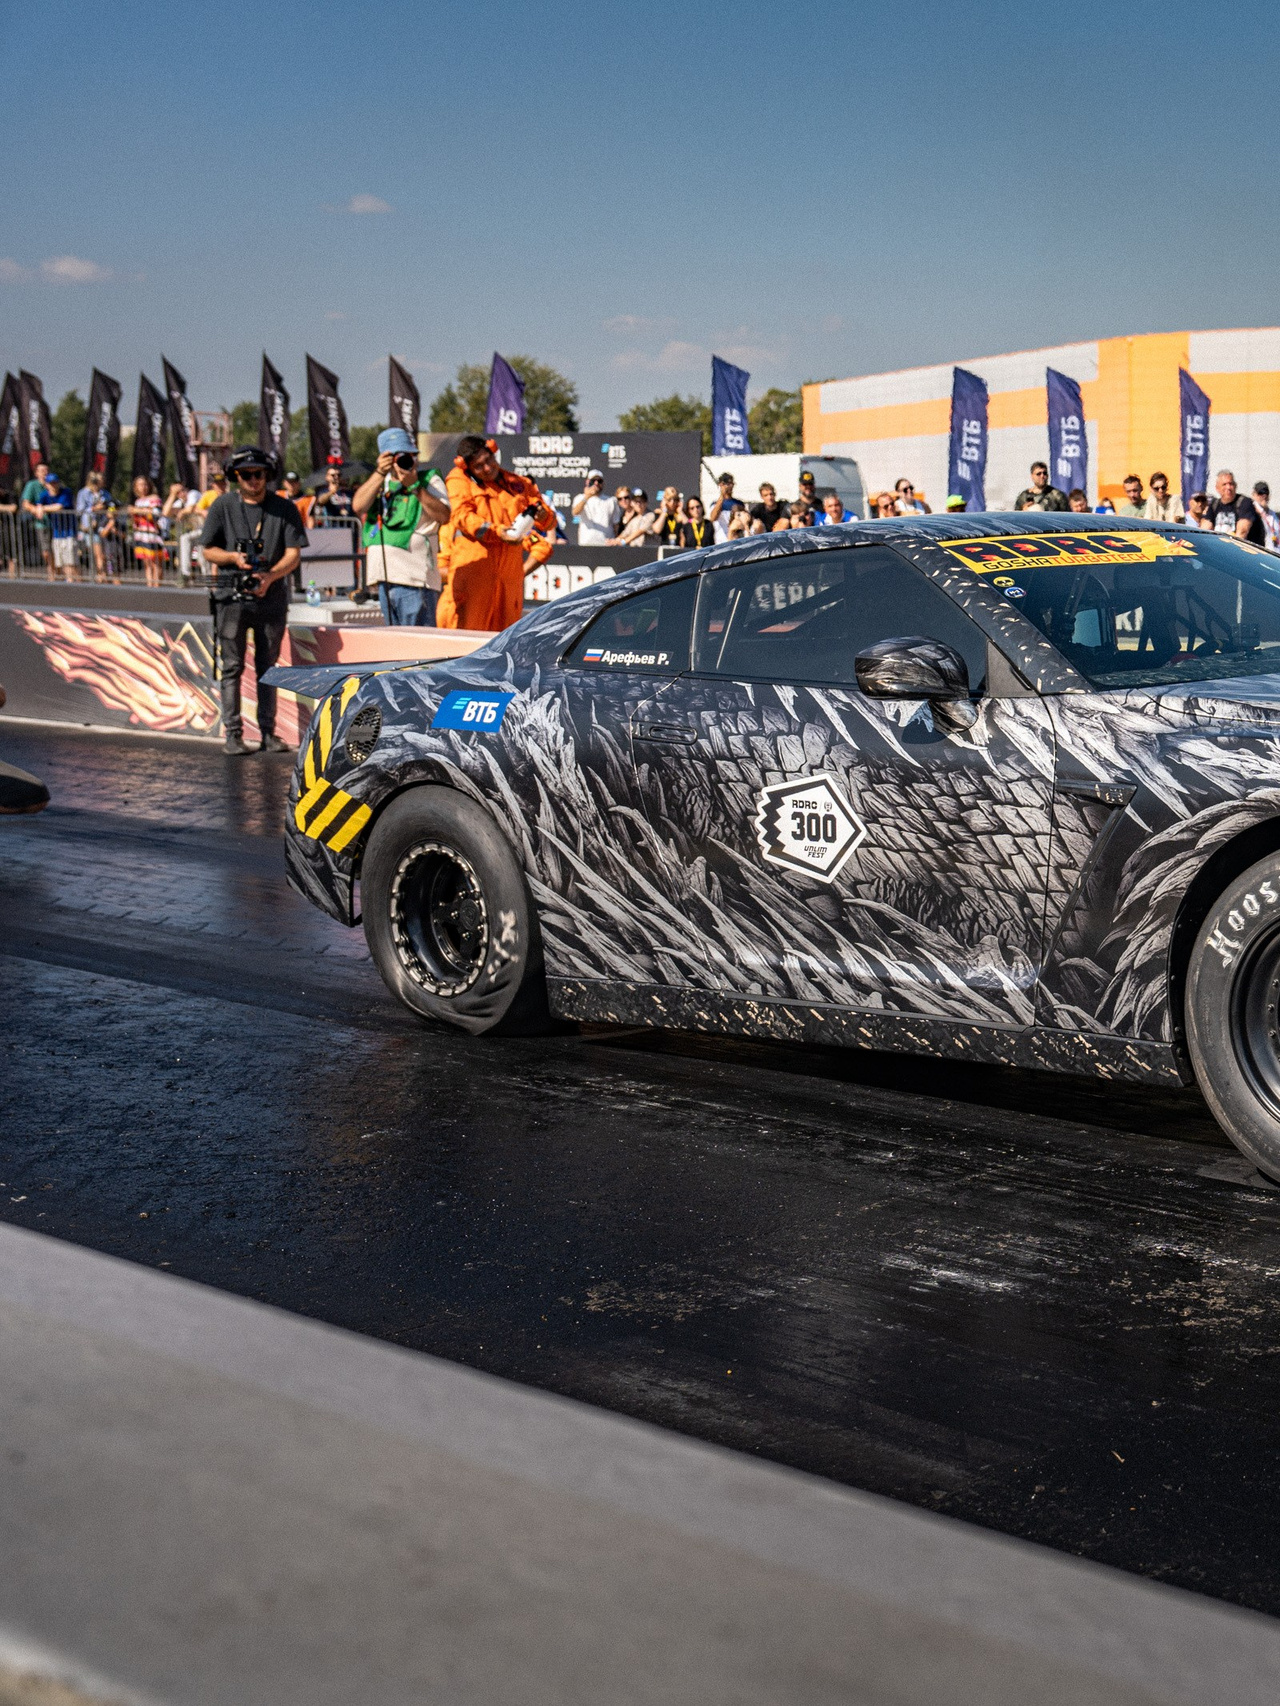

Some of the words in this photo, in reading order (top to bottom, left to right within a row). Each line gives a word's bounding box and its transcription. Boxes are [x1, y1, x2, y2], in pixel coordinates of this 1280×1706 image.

[496, 407, 518, 435] ТБ
[724, 407, 744, 449] ВТБ
[1061, 415, 1081, 457] ВТБ
[1187, 414, 1205, 456] ВТБ
[961, 418, 981, 460] ВТБ
[946, 535, 1142, 563] RDRC
[601, 650, 656, 666] Арефьев
[657, 652, 670, 666] Р.
[462, 700, 500, 724] ВТБ
[791, 799, 818, 810] RDRC
[791, 811, 837, 843] 300
